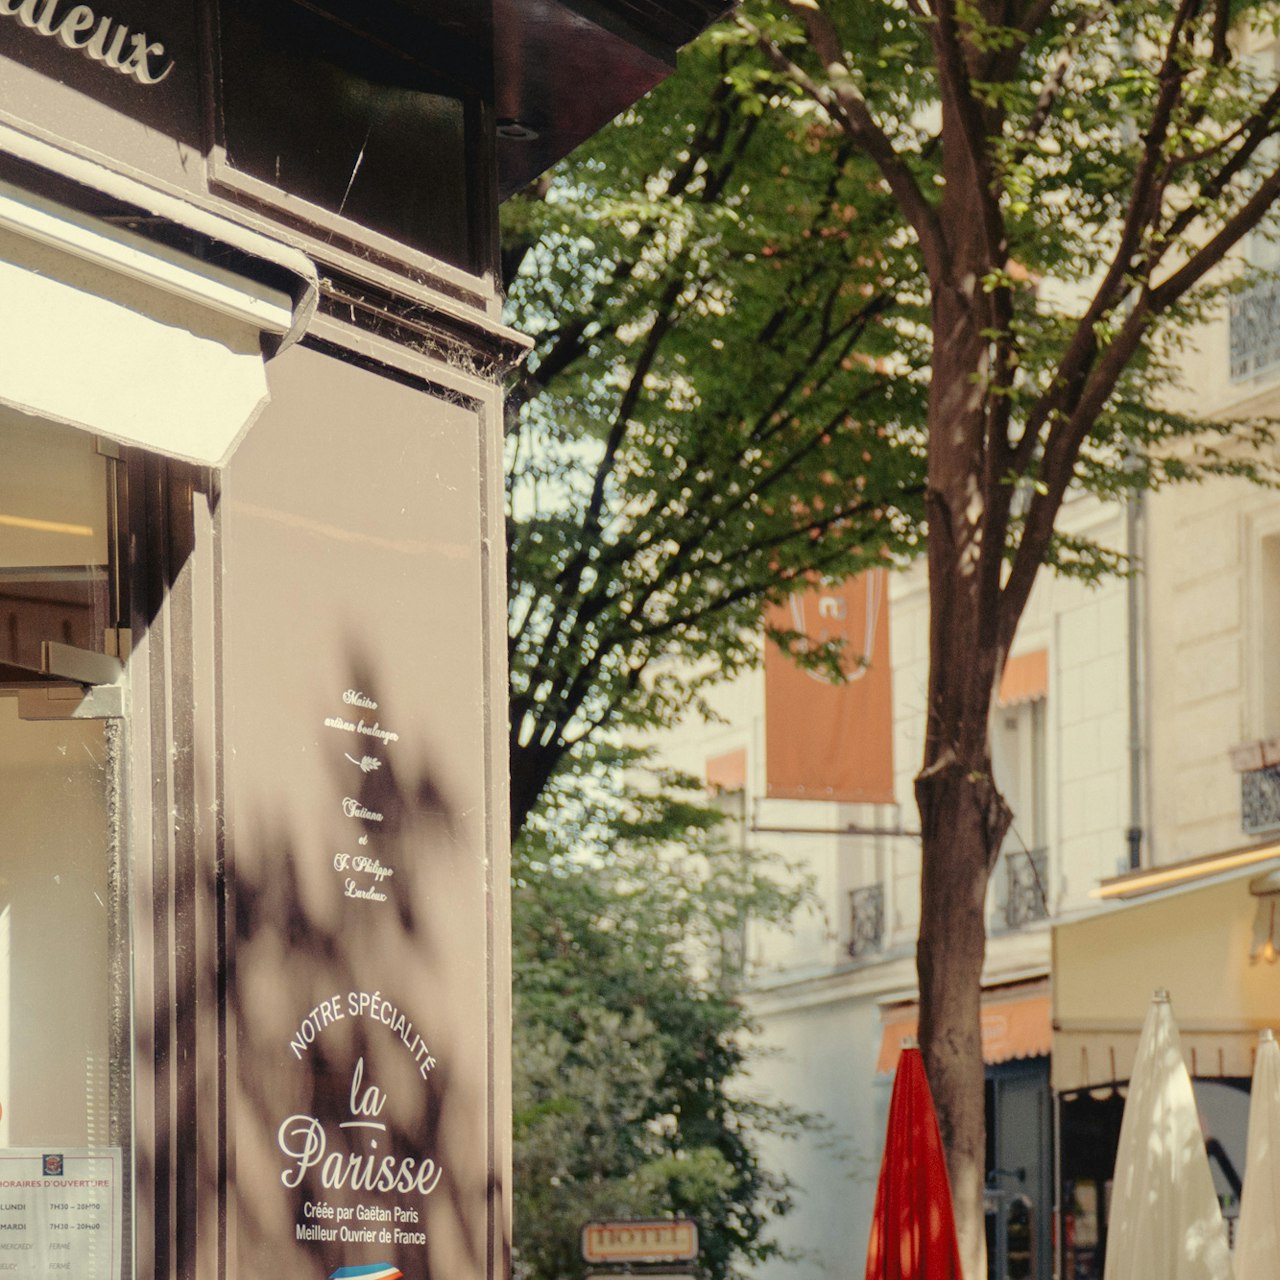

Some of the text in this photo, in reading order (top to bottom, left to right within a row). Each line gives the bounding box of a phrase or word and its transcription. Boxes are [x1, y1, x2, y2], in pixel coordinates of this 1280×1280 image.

[324, 716, 399, 746] artisan boulanger
[342, 796, 384, 823] Tatiana
[358, 834, 369, 846] et
[352, 855, 394, 882] Philippe
[344, 877, 388, 902] Lardeux
[290, 990, 437, 1080] NOTRE SPÉCIALITÉ
[350, 1056, 387, 1117] la
[278, 1114, 443, 1195] Parisse
[44, 1179, 109, 1188] D'OUVERTURE
[0, 1203, 26, 1211] LUNDI
[303, 1201, 419, 1224] Créée par Gaëtan Paris
[0, 1223, 26, 1231] MARDI
[296, 1223, 426, 1245] Meilleur Ouvrier de France
